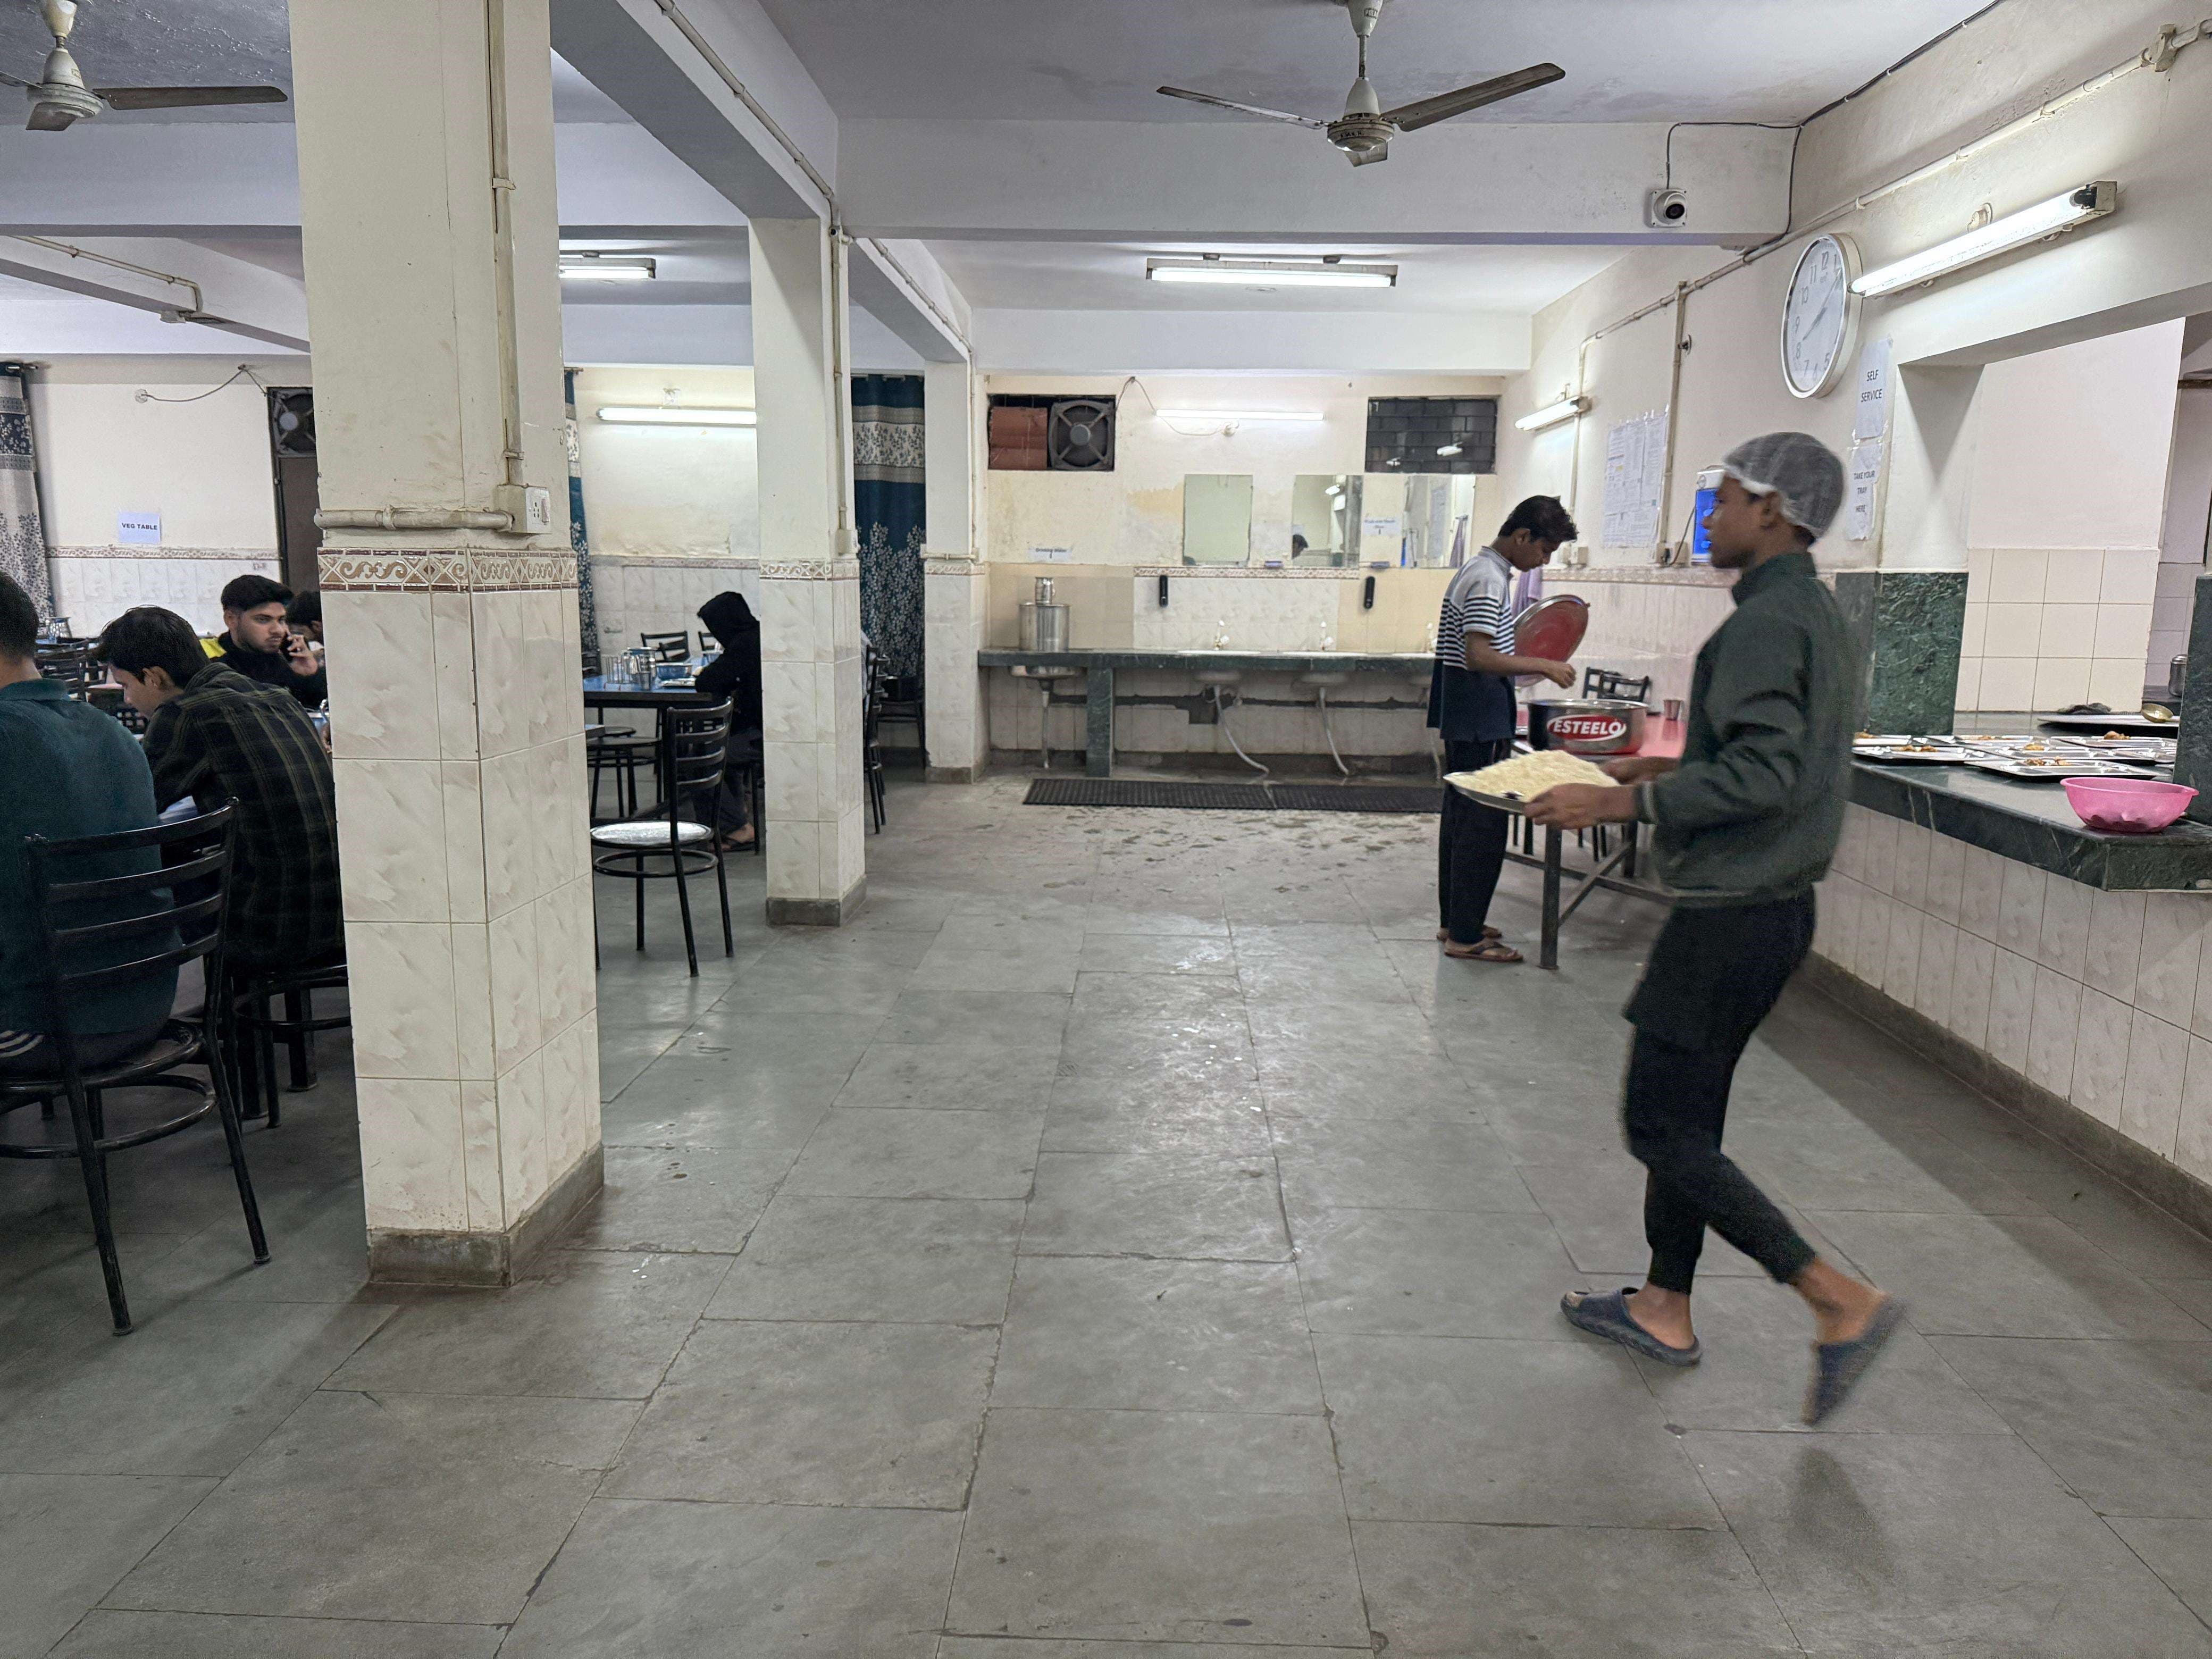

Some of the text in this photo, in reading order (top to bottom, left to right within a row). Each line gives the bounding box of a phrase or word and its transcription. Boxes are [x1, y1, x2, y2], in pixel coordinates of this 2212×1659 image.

[1821, 251, 1829, 271] 12
[1810, 264, 1817, 284] 11
[1800, 286, 1809, 305] 10
[1796, 316, 1800, 333] 9
[1796, 342, 1802, 359] 8
[1803, 359, 1809, 377] 7
[1824, 352, 1830, 371] 5
[1866, 370, 1879, 382] SELF
[1861, 389, 1883, 403] SERVICE
[1553, 718, 1623, 735] ESTEELO
